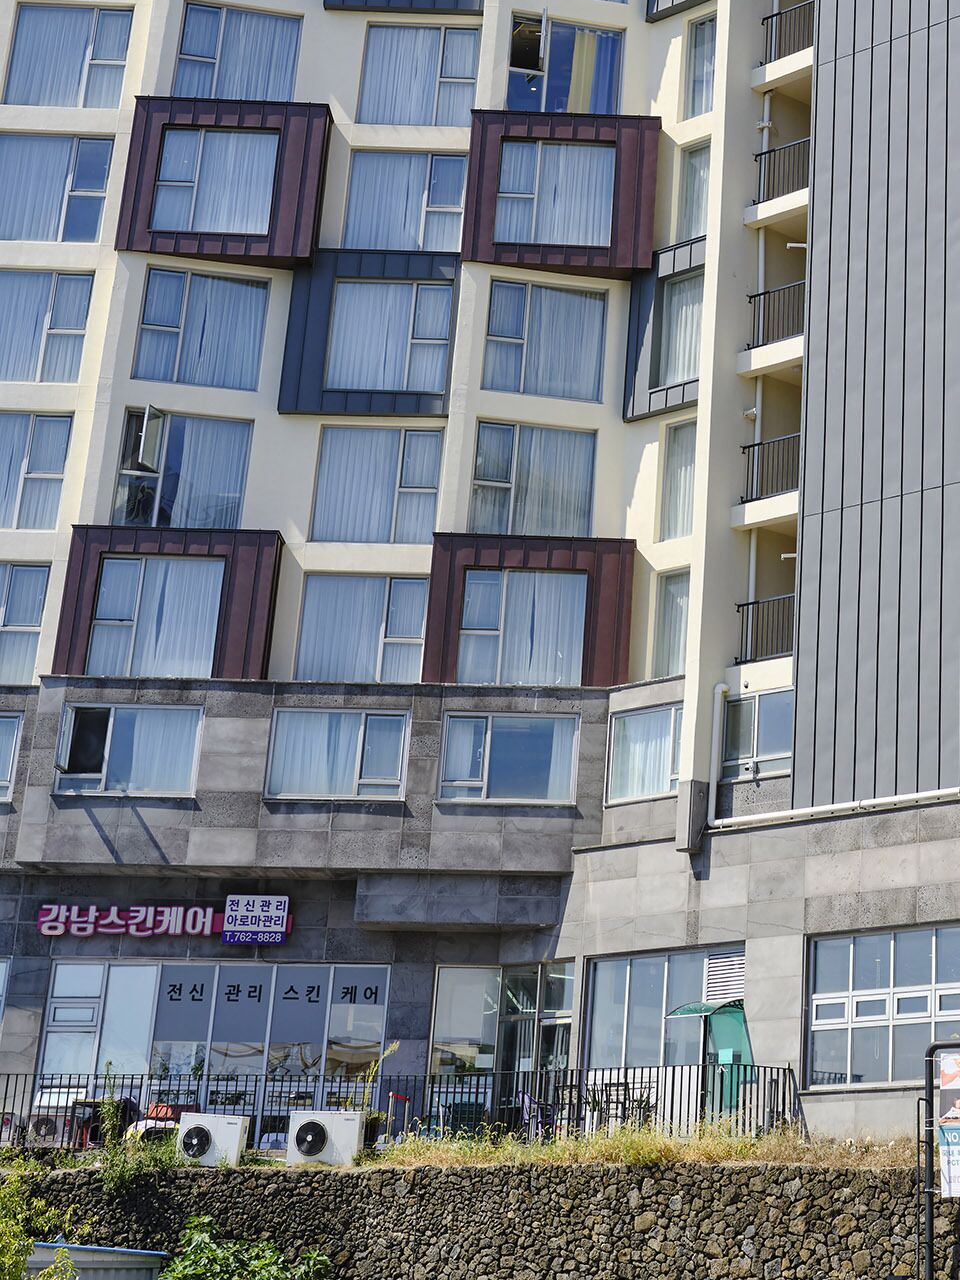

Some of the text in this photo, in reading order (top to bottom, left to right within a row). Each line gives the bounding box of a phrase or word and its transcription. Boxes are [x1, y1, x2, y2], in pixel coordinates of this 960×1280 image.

[40, 904, 214, 937] 강남스킨케어
[226, 913, 284, 928] 아로마관리
[225, 932, 282, 943] T.762-8828
